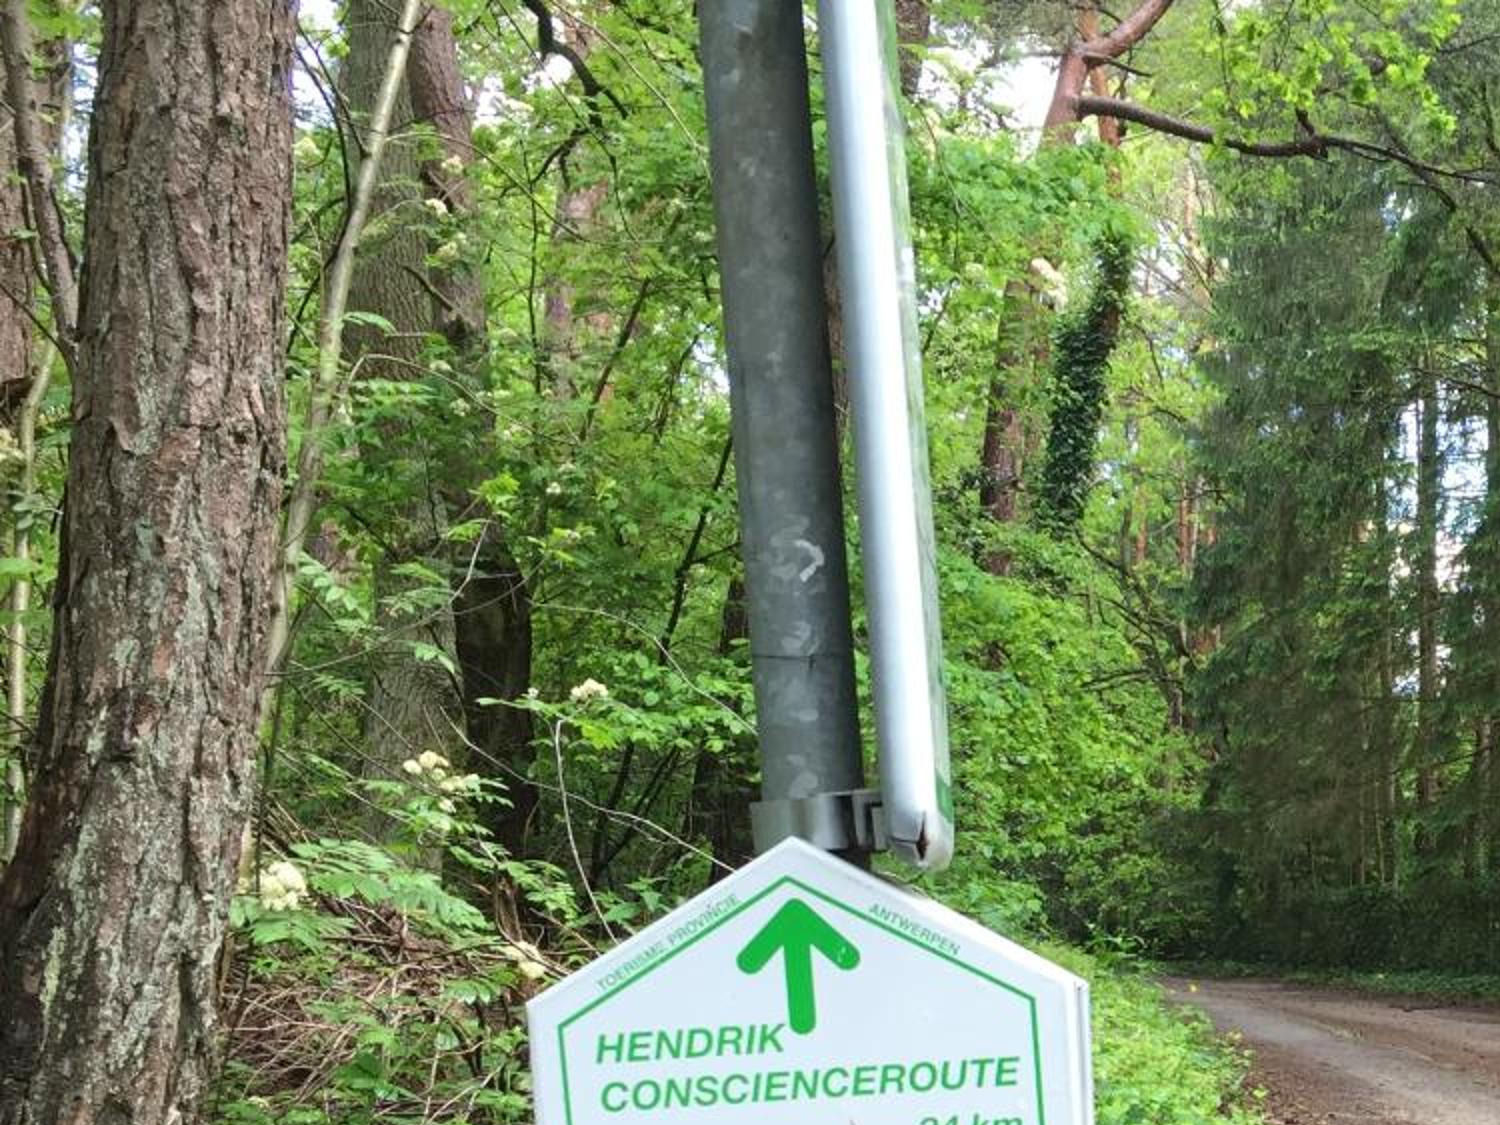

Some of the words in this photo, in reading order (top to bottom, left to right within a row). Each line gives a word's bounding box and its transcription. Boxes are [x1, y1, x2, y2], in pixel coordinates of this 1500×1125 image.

[869, 903, 961, 955] ANTWERPEN
[596, 1023, 785, 1064] HENDRIK
[601, 1056, 1020, 1112] CONSCIENCEROUTE
